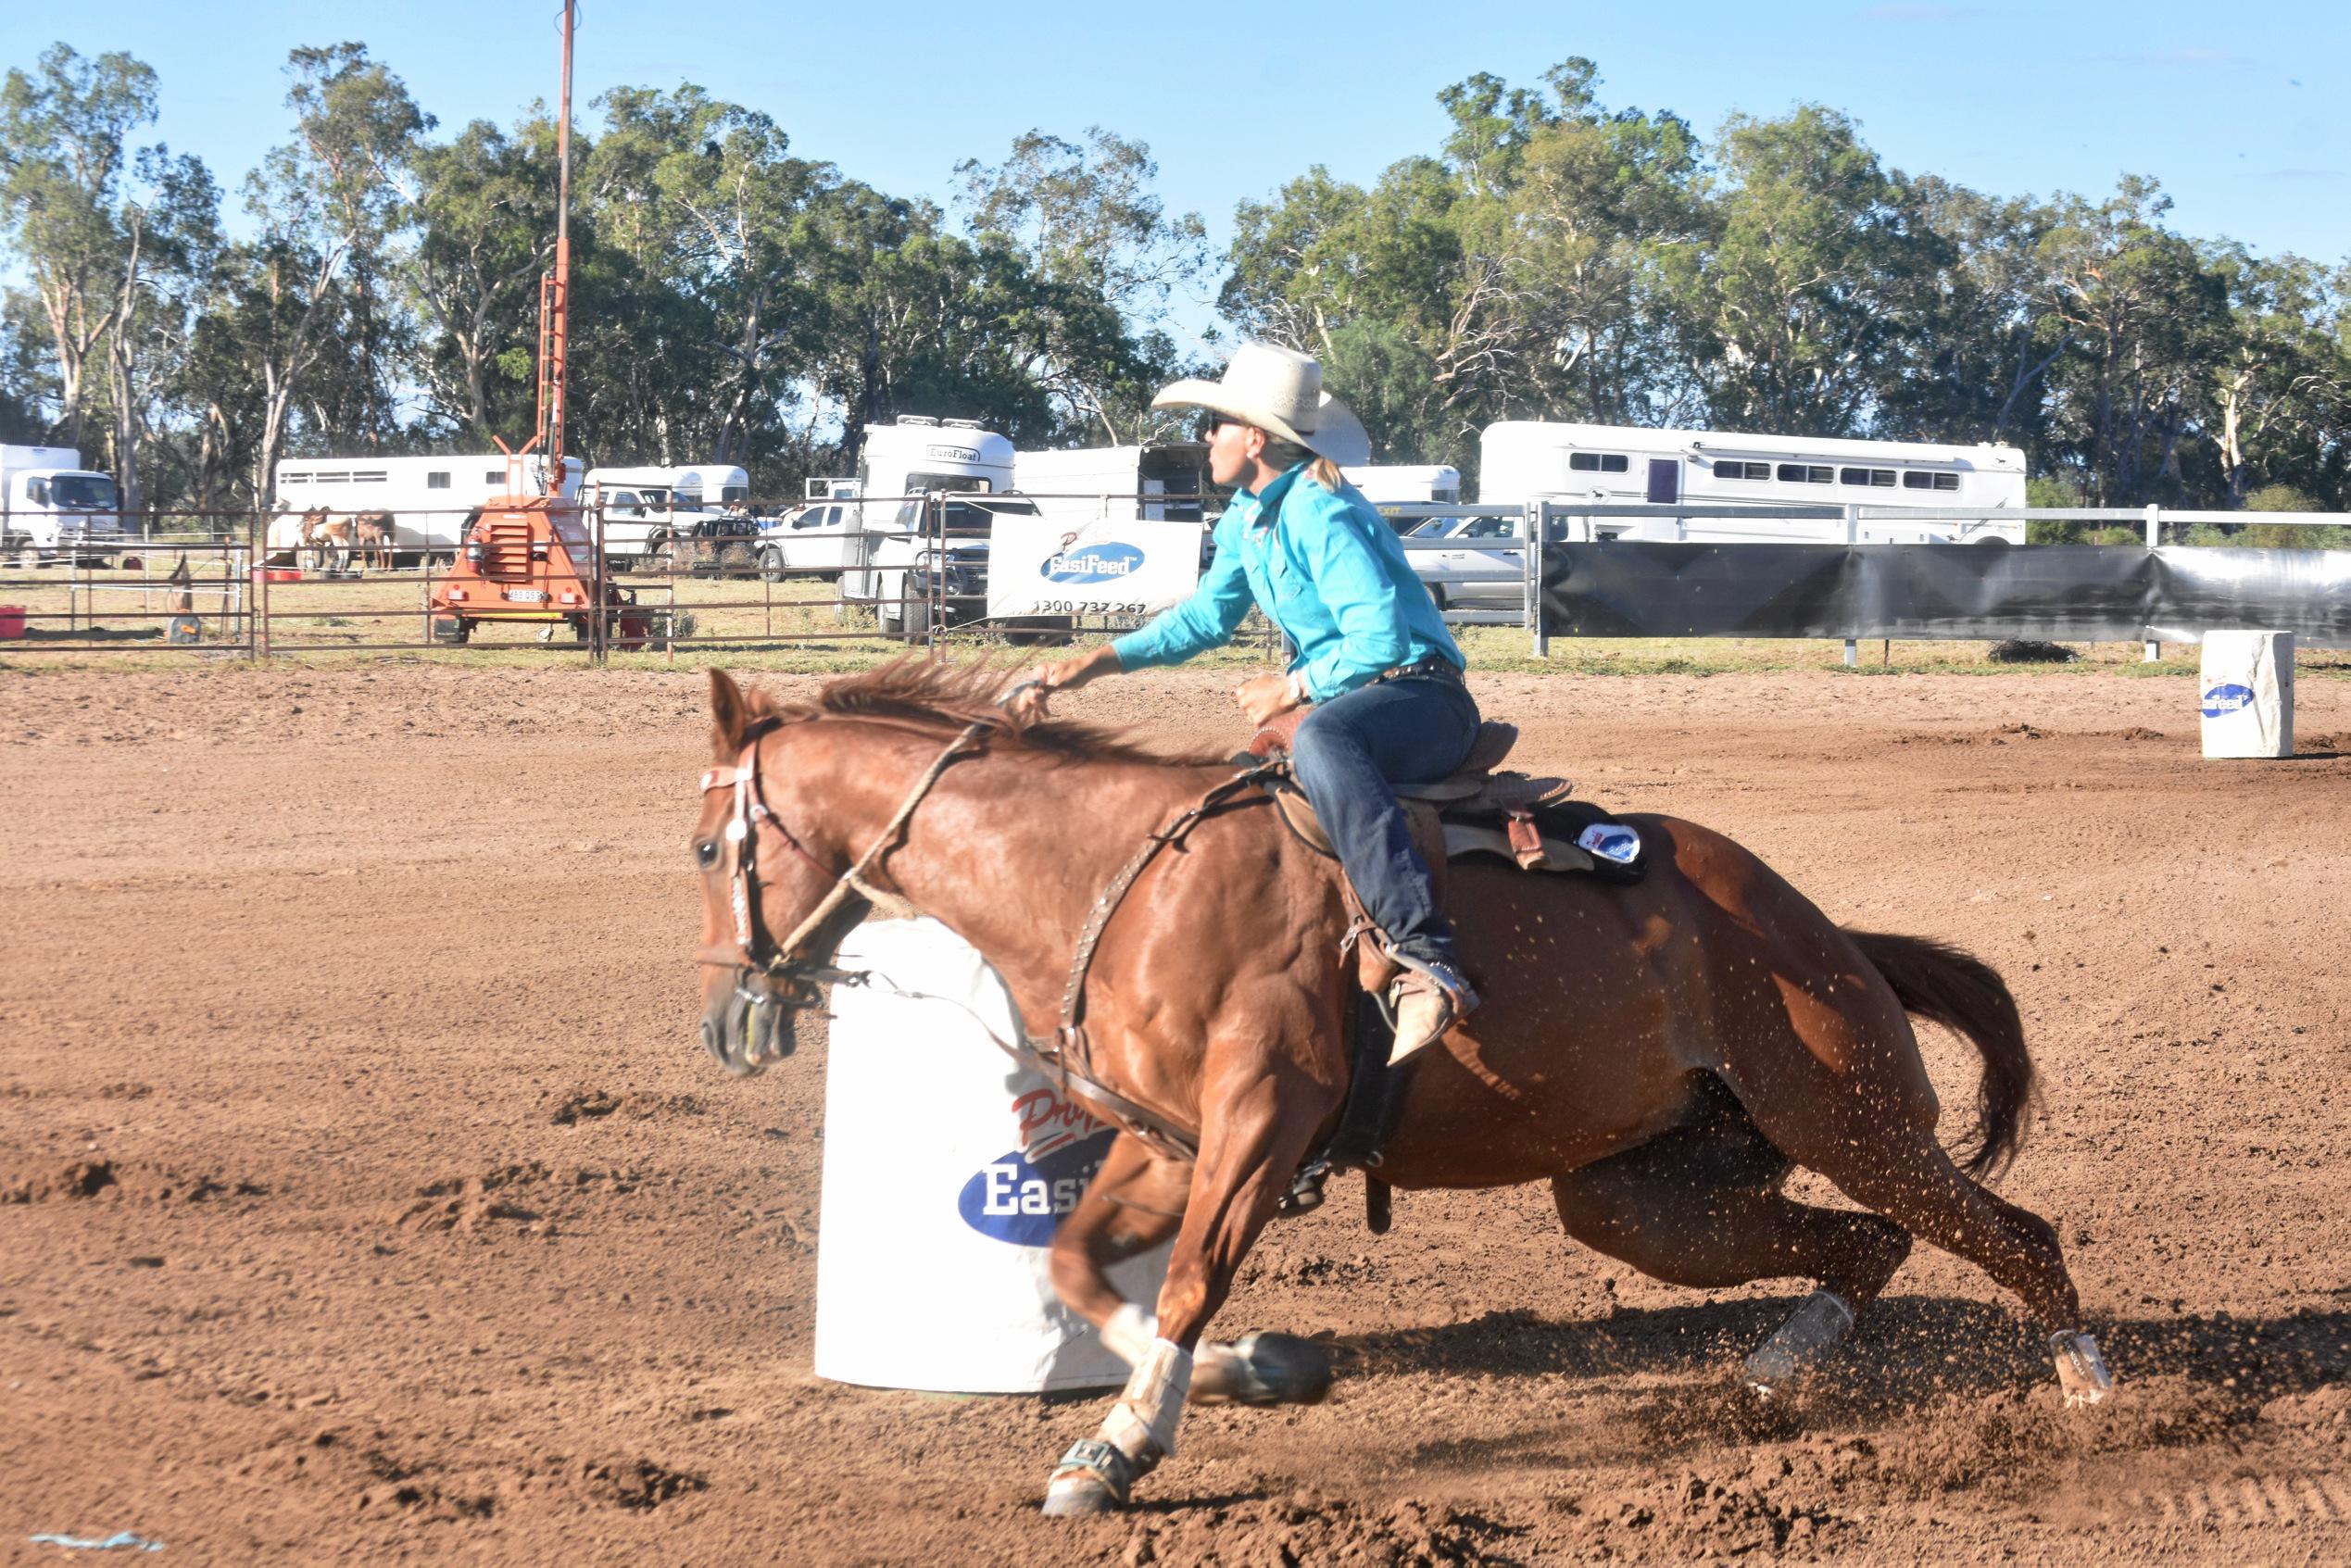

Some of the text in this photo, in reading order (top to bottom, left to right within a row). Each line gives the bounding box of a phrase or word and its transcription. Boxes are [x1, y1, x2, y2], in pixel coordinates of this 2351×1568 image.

[929, 447, 976, 461] EuroFloat
[1034, 600, 1147, 615] 1300 732 267
[983, 1160, 1104, 1215] Easi
